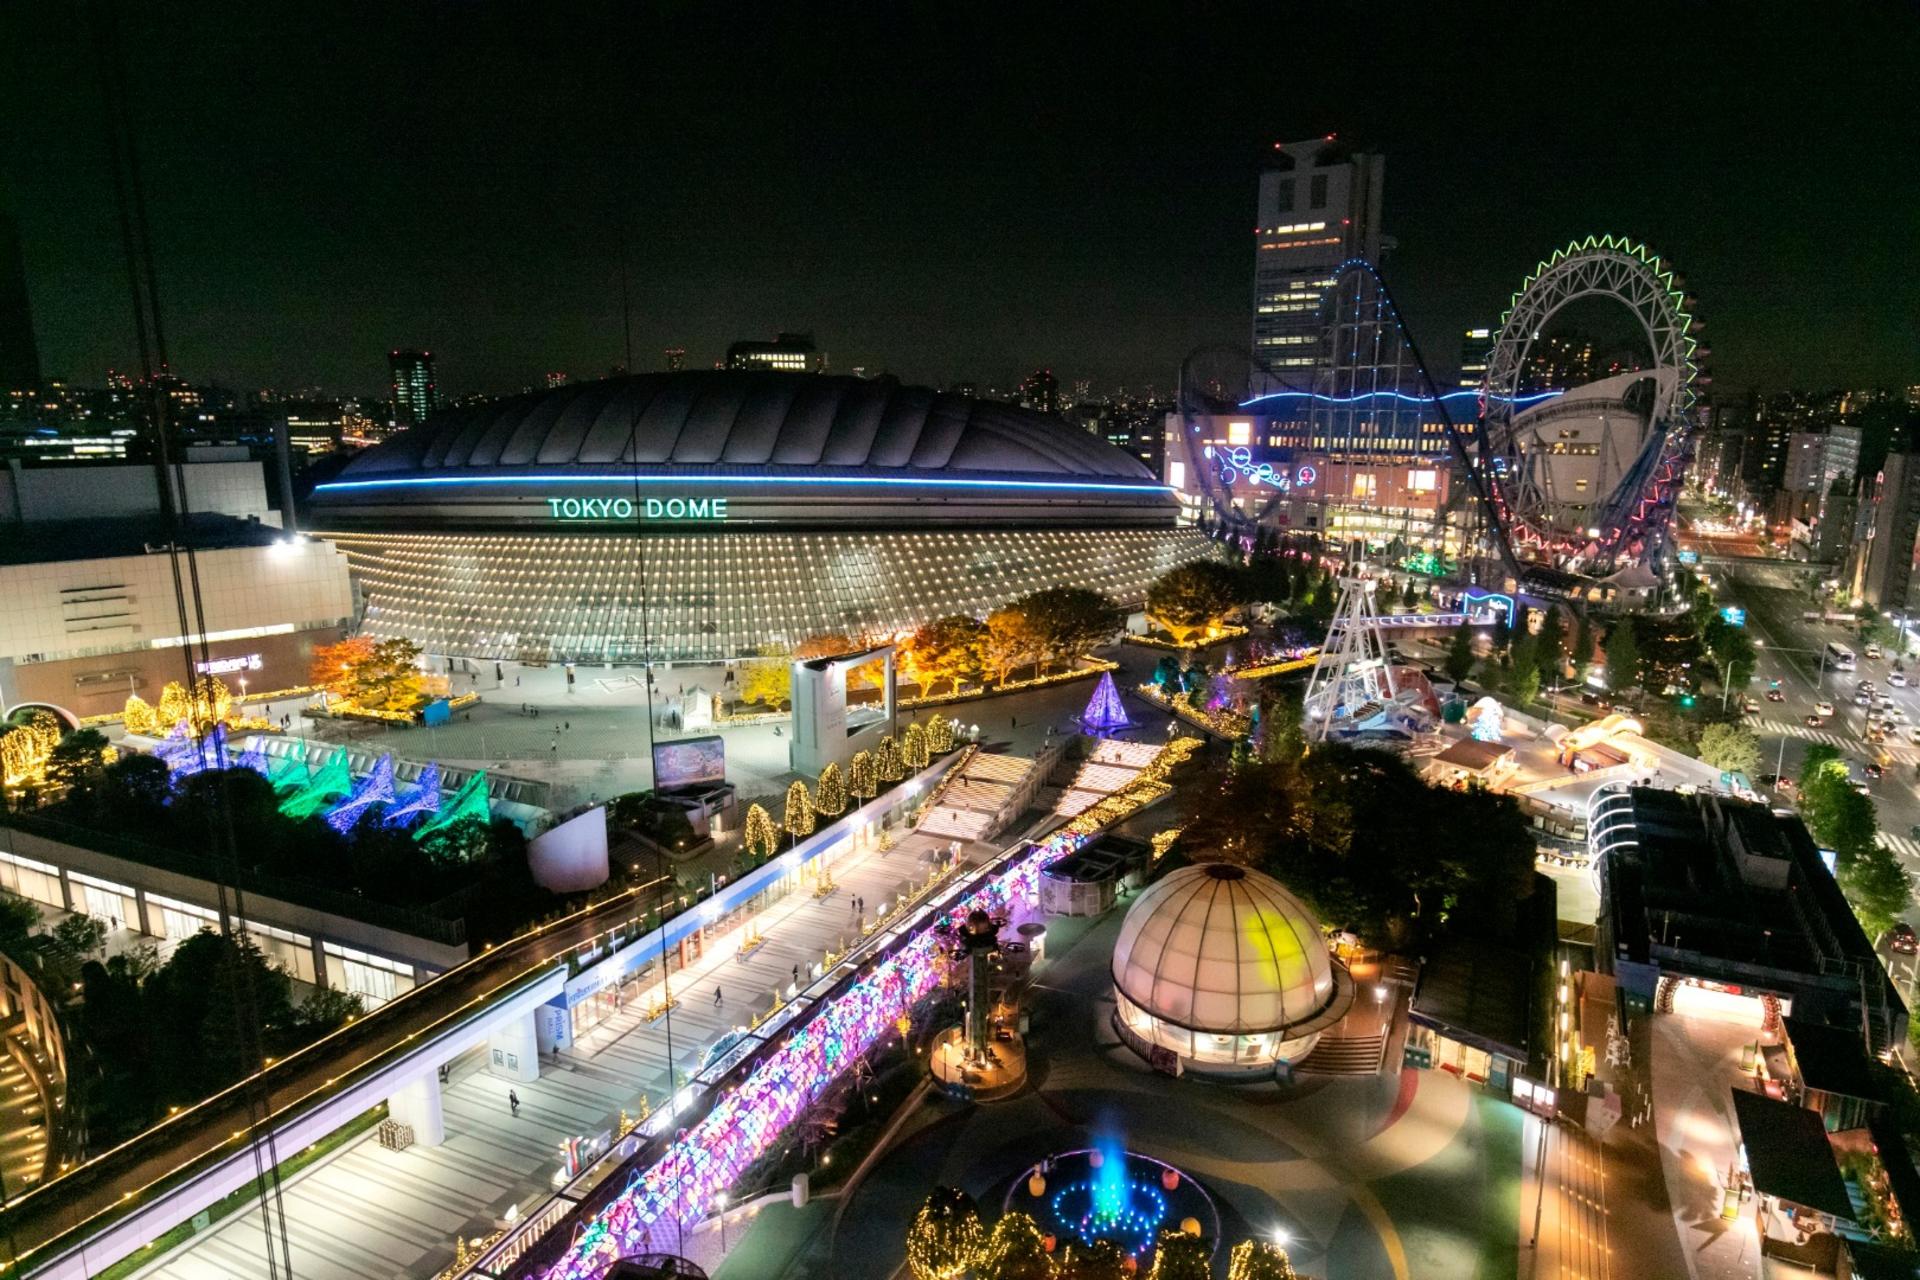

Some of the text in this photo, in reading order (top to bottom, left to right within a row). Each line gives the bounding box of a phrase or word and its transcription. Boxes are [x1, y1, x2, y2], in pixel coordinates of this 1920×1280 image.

[548, 498, 728, 518] TOKYO DOME
[554, 1009, 564, 1041] PRISM
